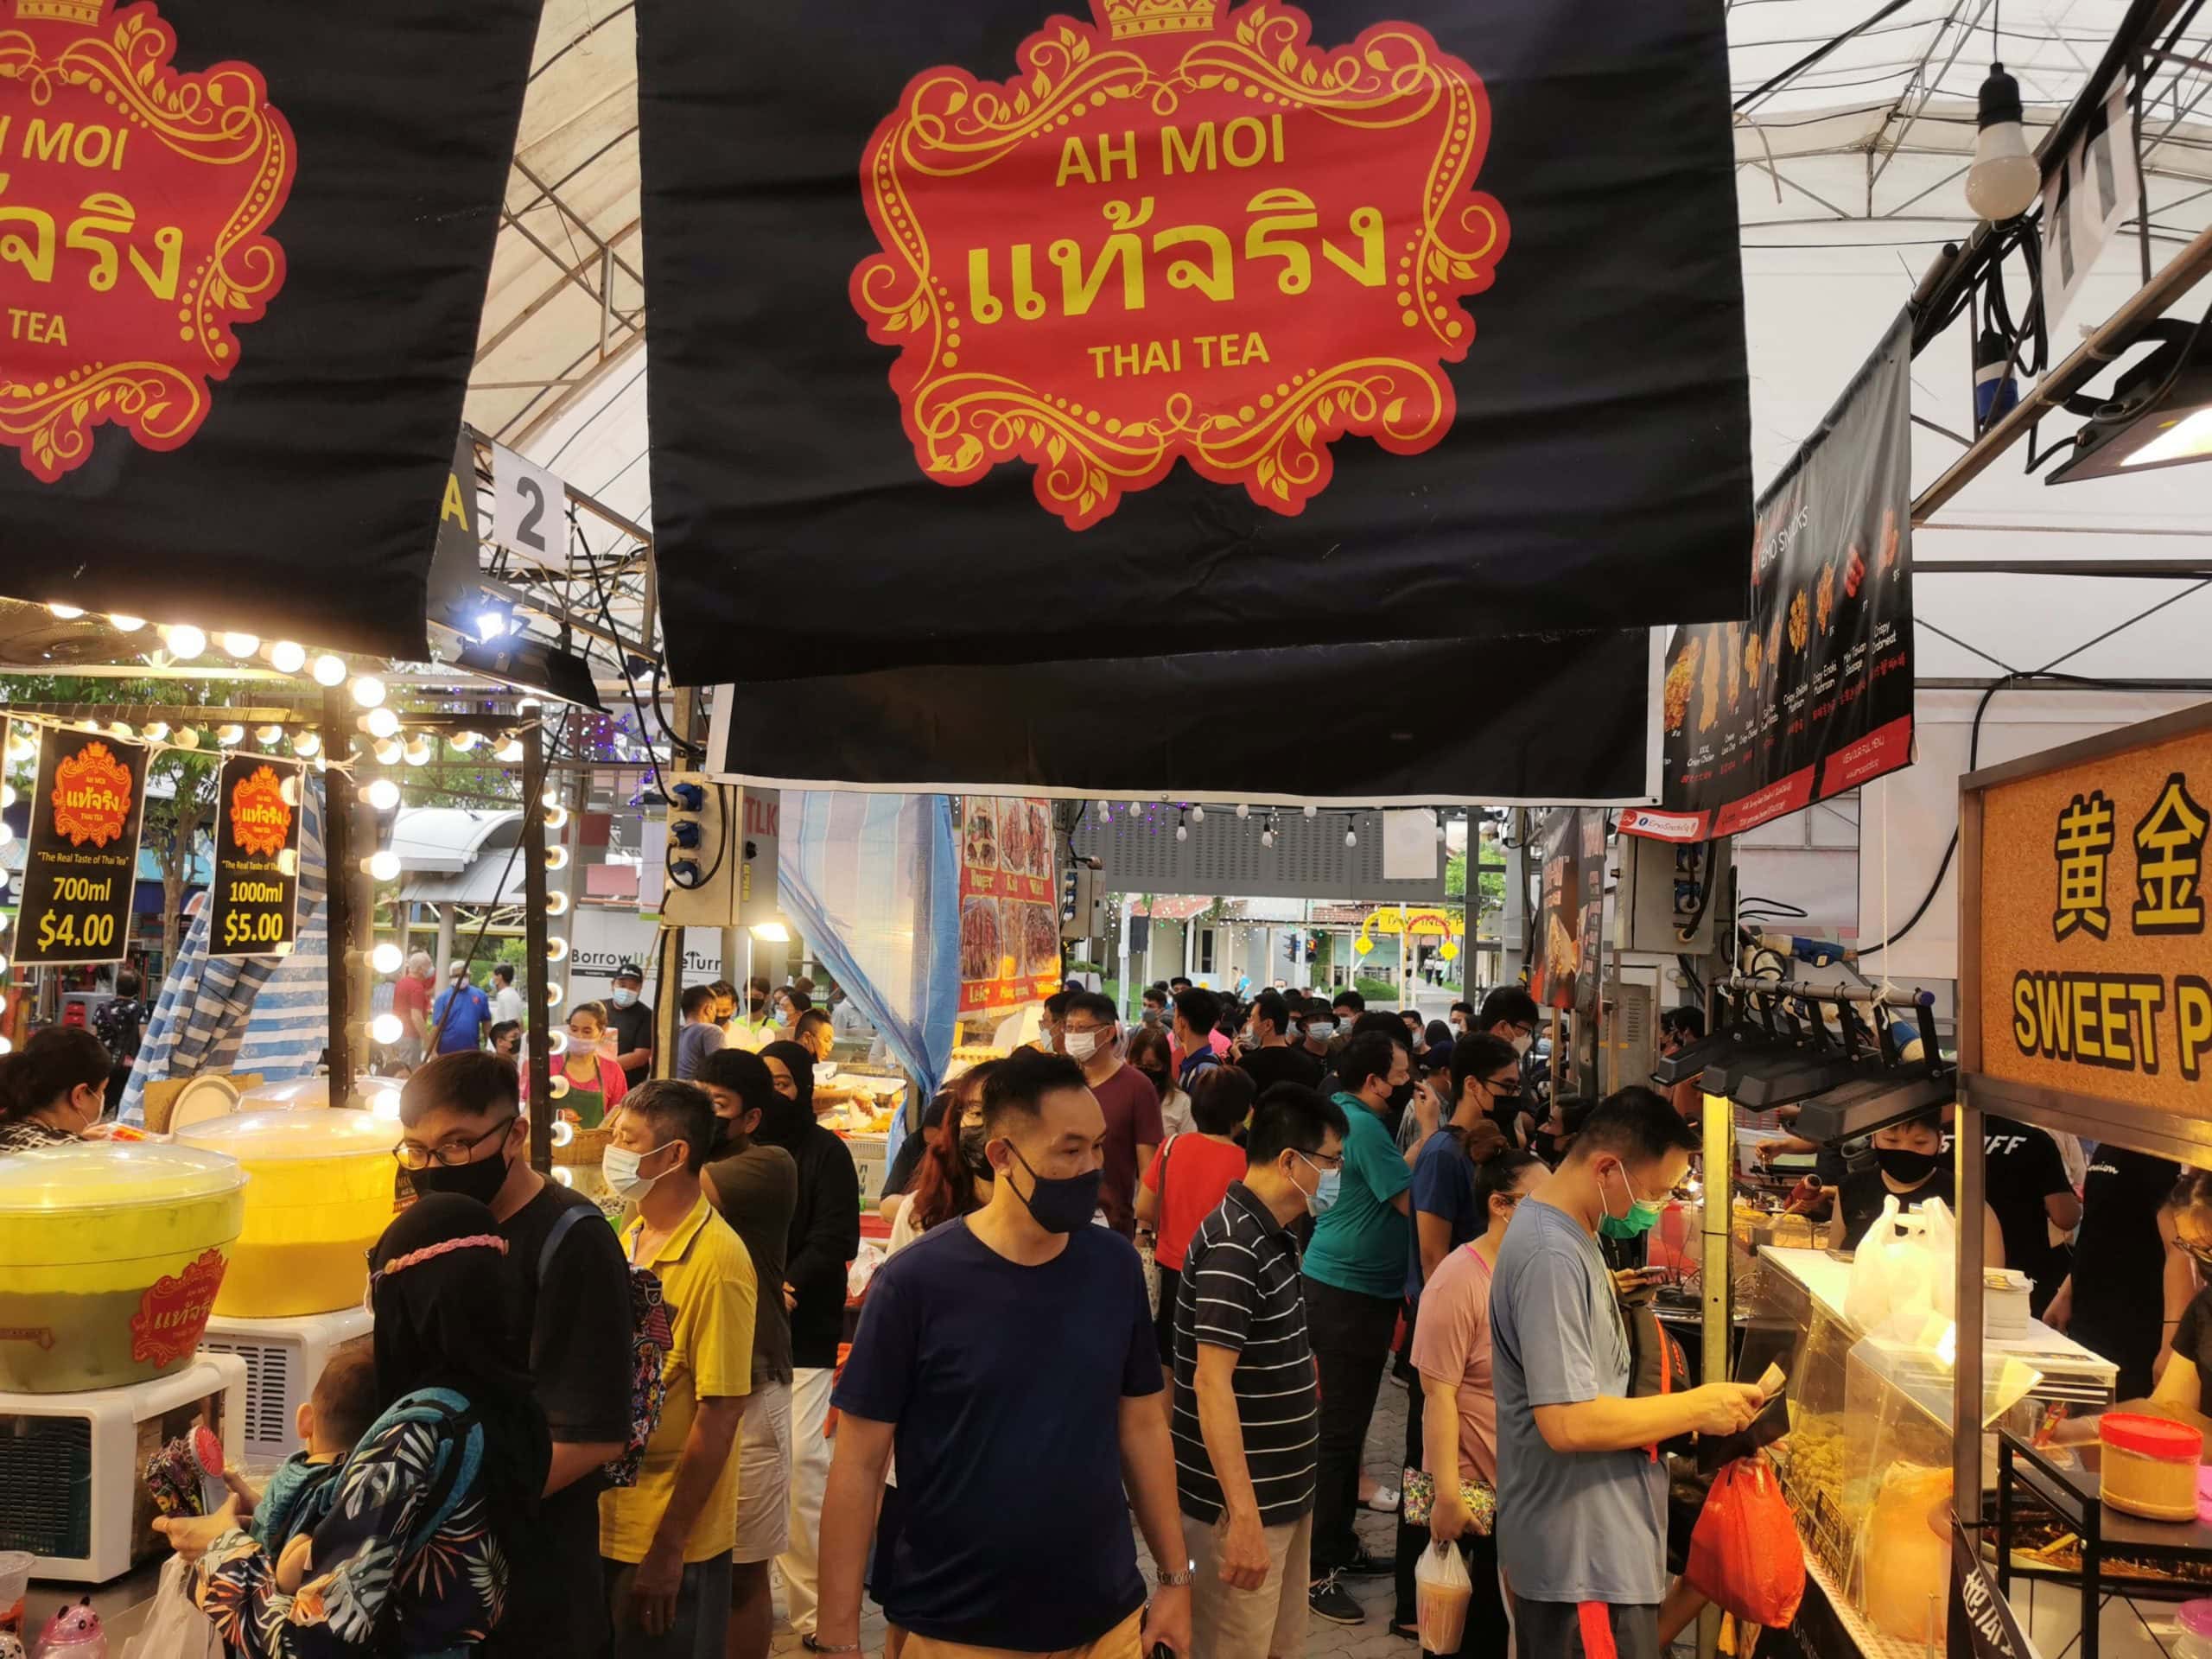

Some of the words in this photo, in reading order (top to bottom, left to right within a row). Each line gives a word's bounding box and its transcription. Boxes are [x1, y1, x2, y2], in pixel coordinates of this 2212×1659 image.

[22, 118, 129, 171] MOI
[1056, 130, 1138, 188] AH
[1161, 113, 1285, 175] MOI
[968, 187, 1387, 325] แท้จริง
[8, 308, 67, 346] TEA
[1088, 339, 1182, 378] THAI
[1193, 332, 1270, 369] TEA
[516, 476, 545, 552] 2
[67, 786, 120, 812] แท้จริง
[56, 852, 73, 862] Real
[74, 854, 92, 865] Taste
[53, 877, 111, 901] 700ml
[230, 881, 283, 903] 1000ml
[37, 908, 114, 953] $4.00
[224, 908, 283, 947] $5.00
[2013, 971, 2162, 1071] SWEET
[1941, 1134, 2027, 1155] SFF
